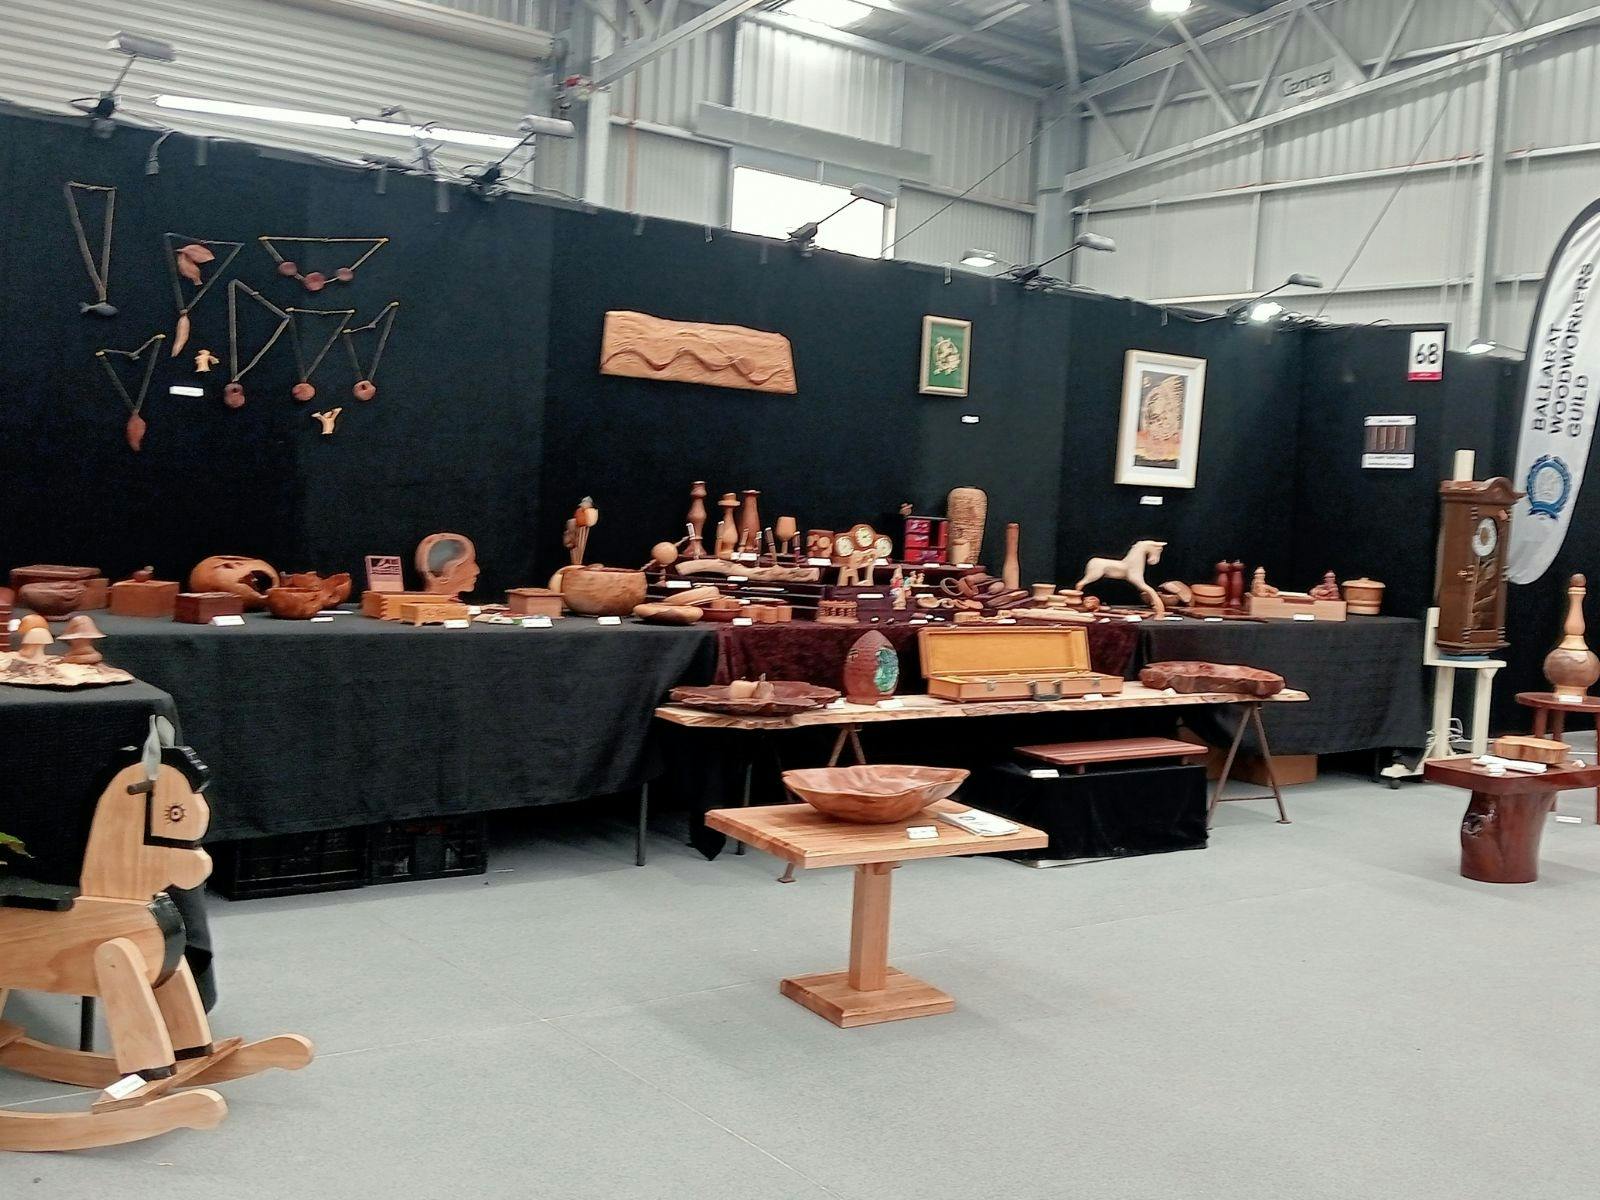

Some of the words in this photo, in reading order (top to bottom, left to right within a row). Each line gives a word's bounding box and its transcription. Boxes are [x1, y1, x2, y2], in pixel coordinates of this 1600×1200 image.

[1414, 344, 1439, 365] 68
[1533, 322, 1563, 431] BALLARAT
[1549, 262, 1594, 434] WOODWORKERS
[1567, 374, 1589, 438] GUILD
